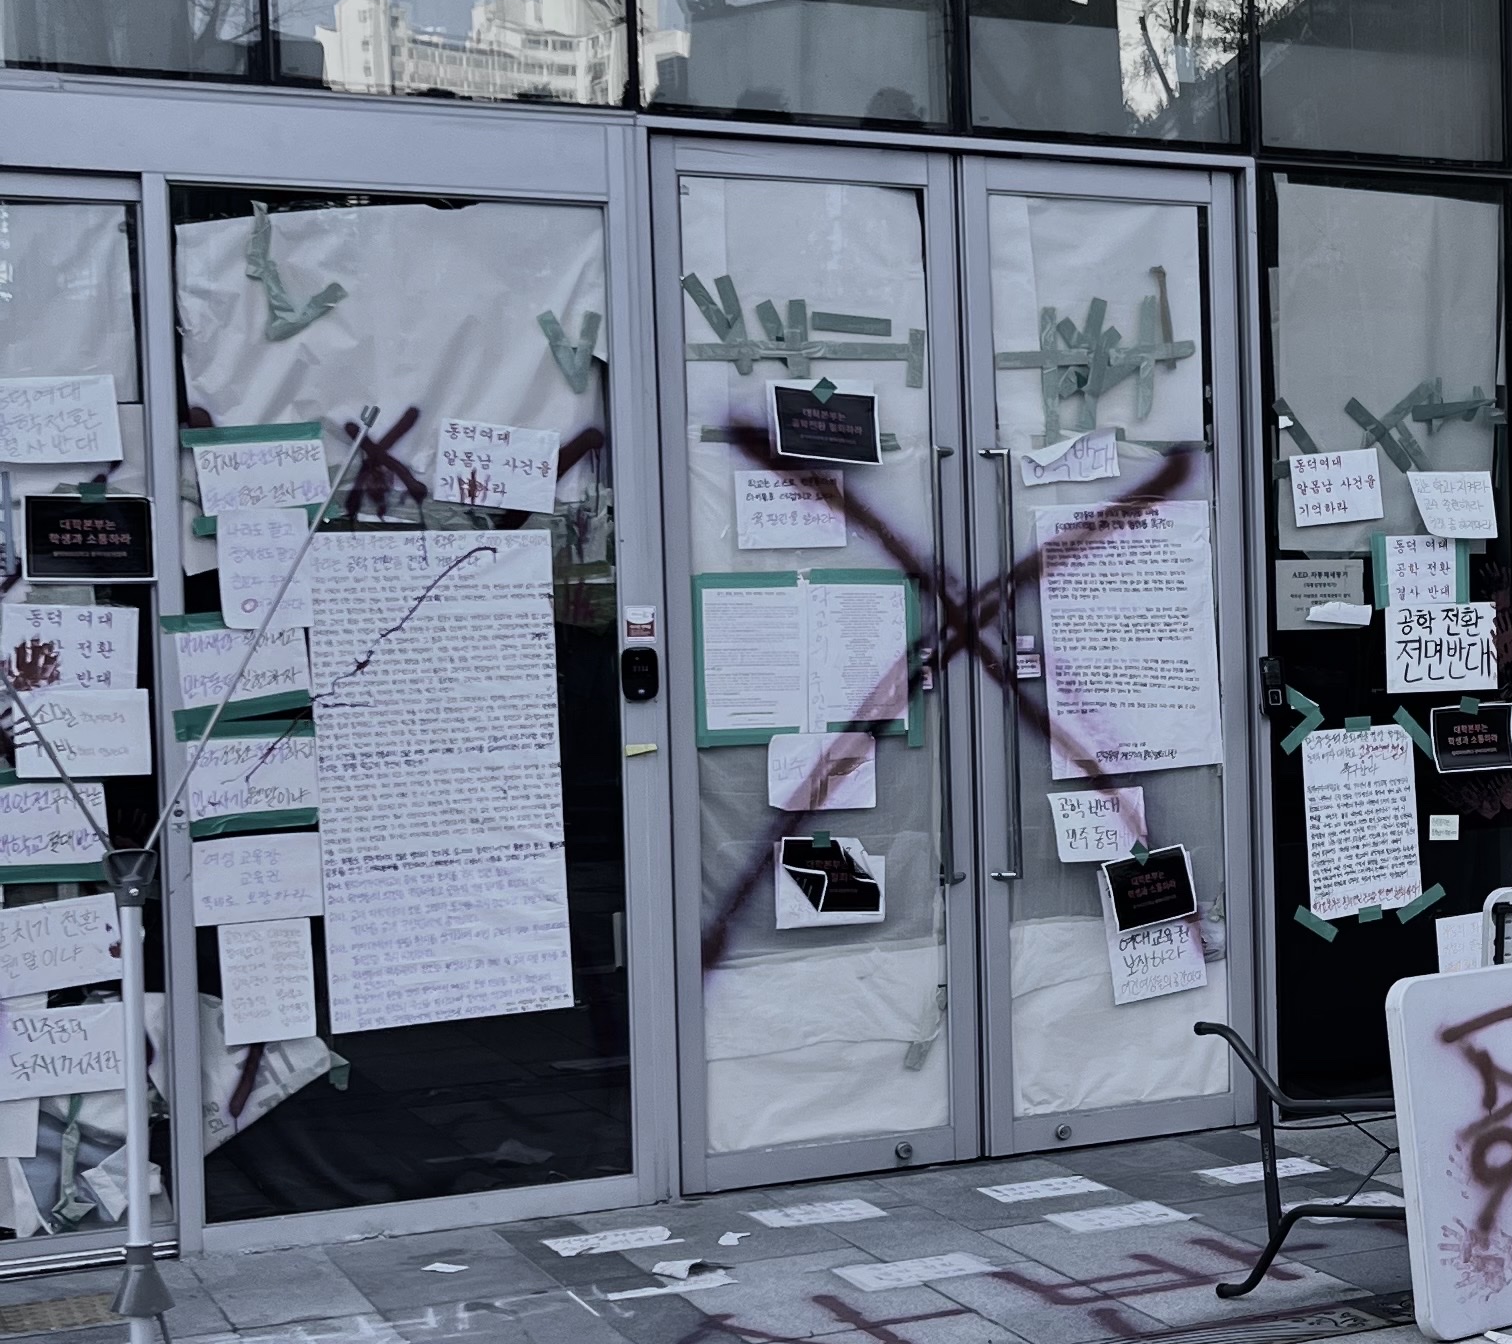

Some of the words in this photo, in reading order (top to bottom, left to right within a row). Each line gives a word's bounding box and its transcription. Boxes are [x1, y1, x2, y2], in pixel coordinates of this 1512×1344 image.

[1294, 455, 1342, 474] 동덕여대
[1296, 478, 1333, 496] 알몸남
[1340, 474, 1376, 490] 사건을
[1299, 499, 1348, 517] 기억하라
[1393, 538, 1417, 554] 동덕
[1425, 537, 1449, 552] 여대
[1395, 561, 1420, 578] 공학
[1427, 560, 1451, 577] 전환
[1396, 585, 1421, 602] 결사
[1427, 584, 1451, 600] 반대
[26, 609, 62, 628] 동덕
[78, 610, 113, 629] 여대
[1396, 607, 1437, 636] 공학
[1440, 606, 1484, 638] 전환
[78, 640, 115, 659] 전환
[1395, 635, 1491, 684] 전면반대
[76, 669, 112, 689] 반대
